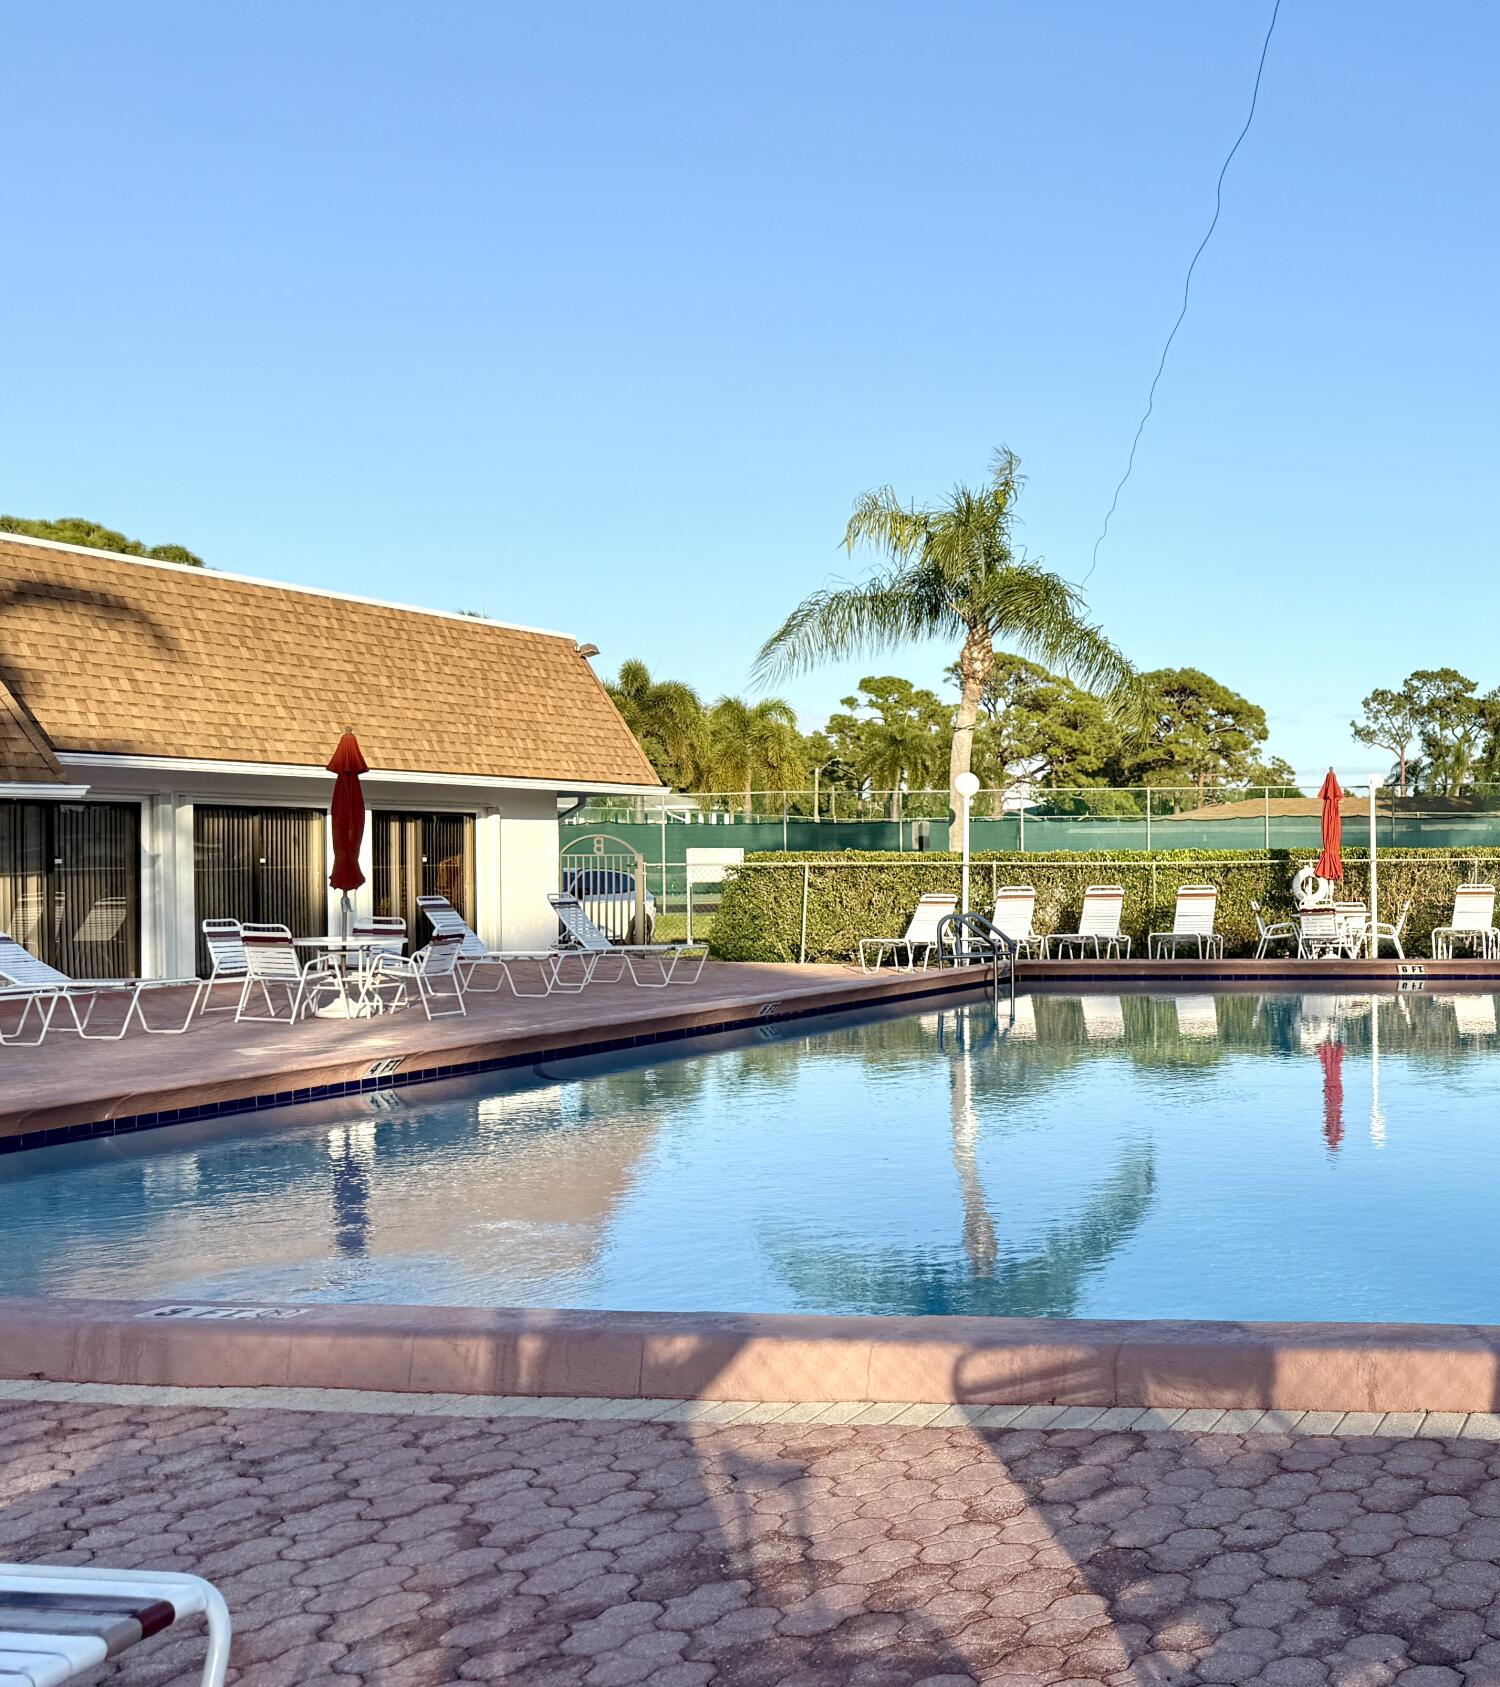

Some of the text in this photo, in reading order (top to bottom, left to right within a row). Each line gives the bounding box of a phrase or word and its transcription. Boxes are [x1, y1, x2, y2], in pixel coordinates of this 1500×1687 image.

[370, 1059, 401, 1074] 4 FT
[194, 1308, 257, 1318] FT
